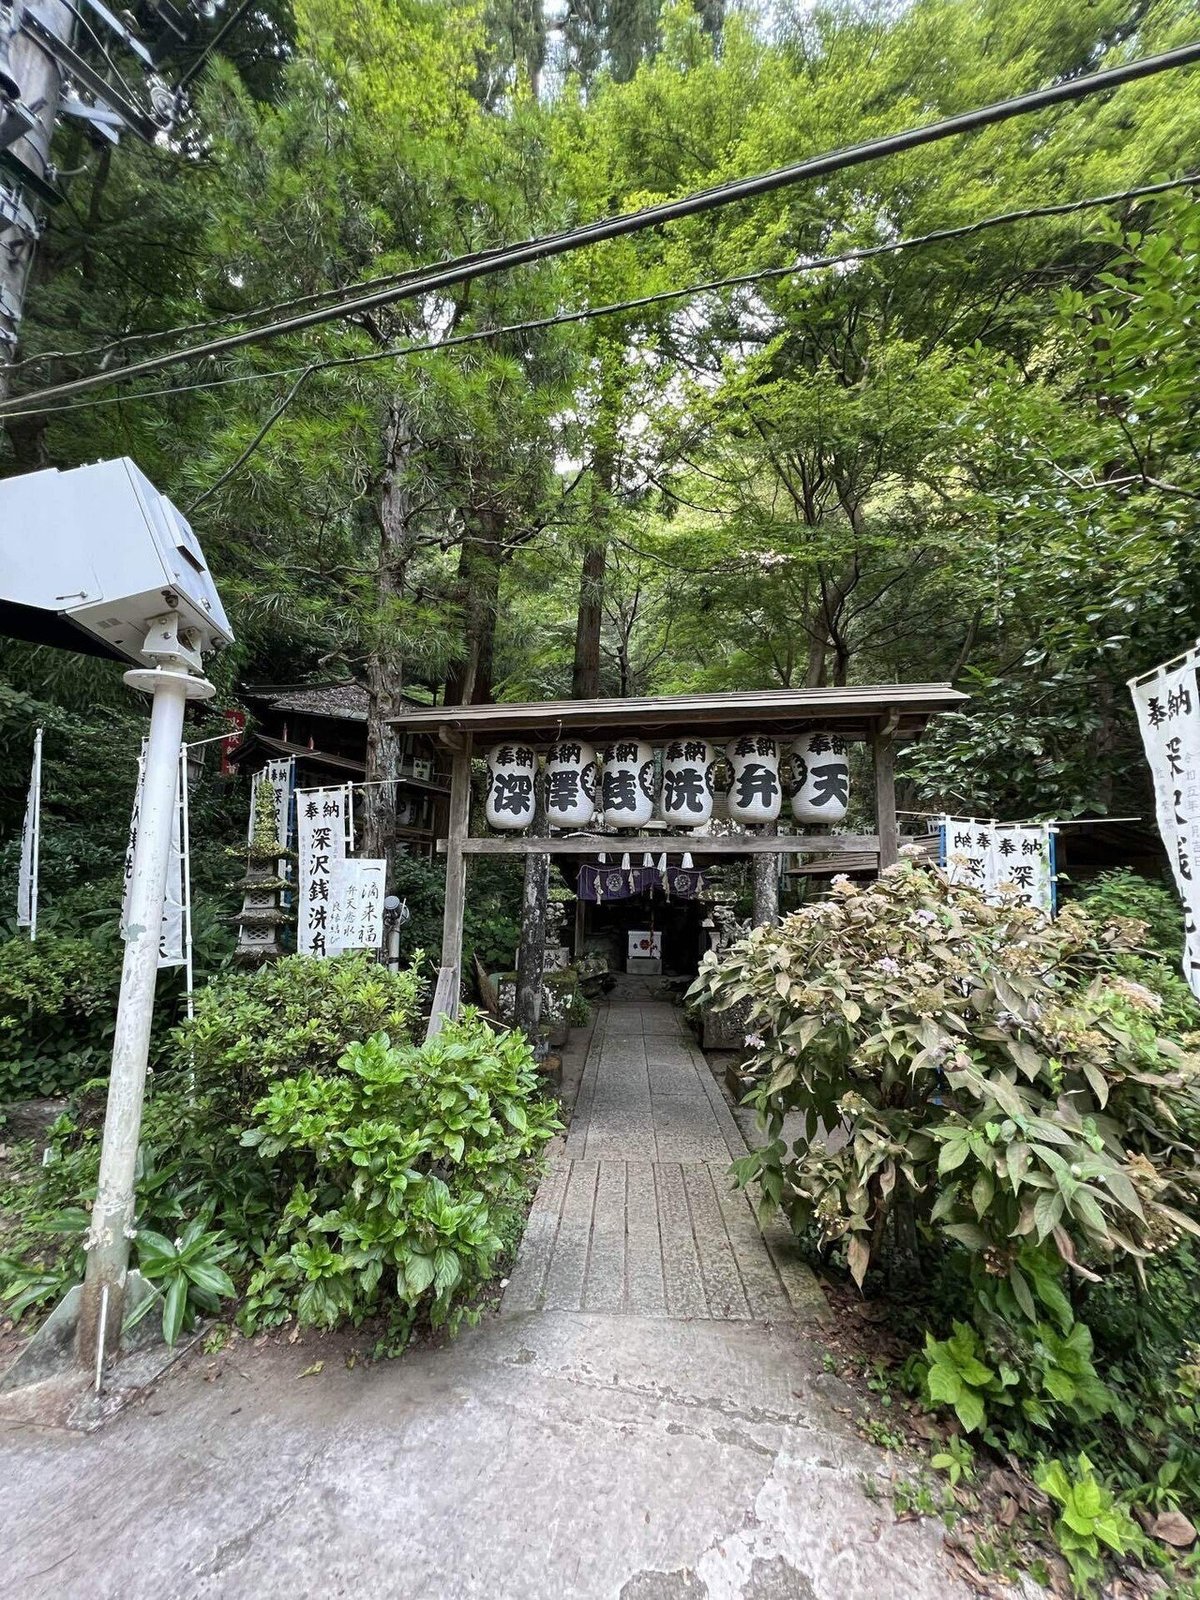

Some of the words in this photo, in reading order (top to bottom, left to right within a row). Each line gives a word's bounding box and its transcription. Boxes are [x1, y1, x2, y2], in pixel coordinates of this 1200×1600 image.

[1148, 684, 1192, 730] 奉納
[665, 741, 706, 763] 奉納
[734, 736, 776, 758] 奉納
[806, 733, 848, 757] 奉納
[496, 746, 533, 769] 奉納
[271, 768, 288, 782] 奉納
[736, 763, 778, 808] 弁
[808, 763, 848, 808] 天
[494, 773, 532, 815] 深
[665, 768, 704, 812] 洗
[304, 801, 340, 820] 奉納
[998, 838, 1043, 857] 奉納
[358, 866, 381, 943] 一滴来福
